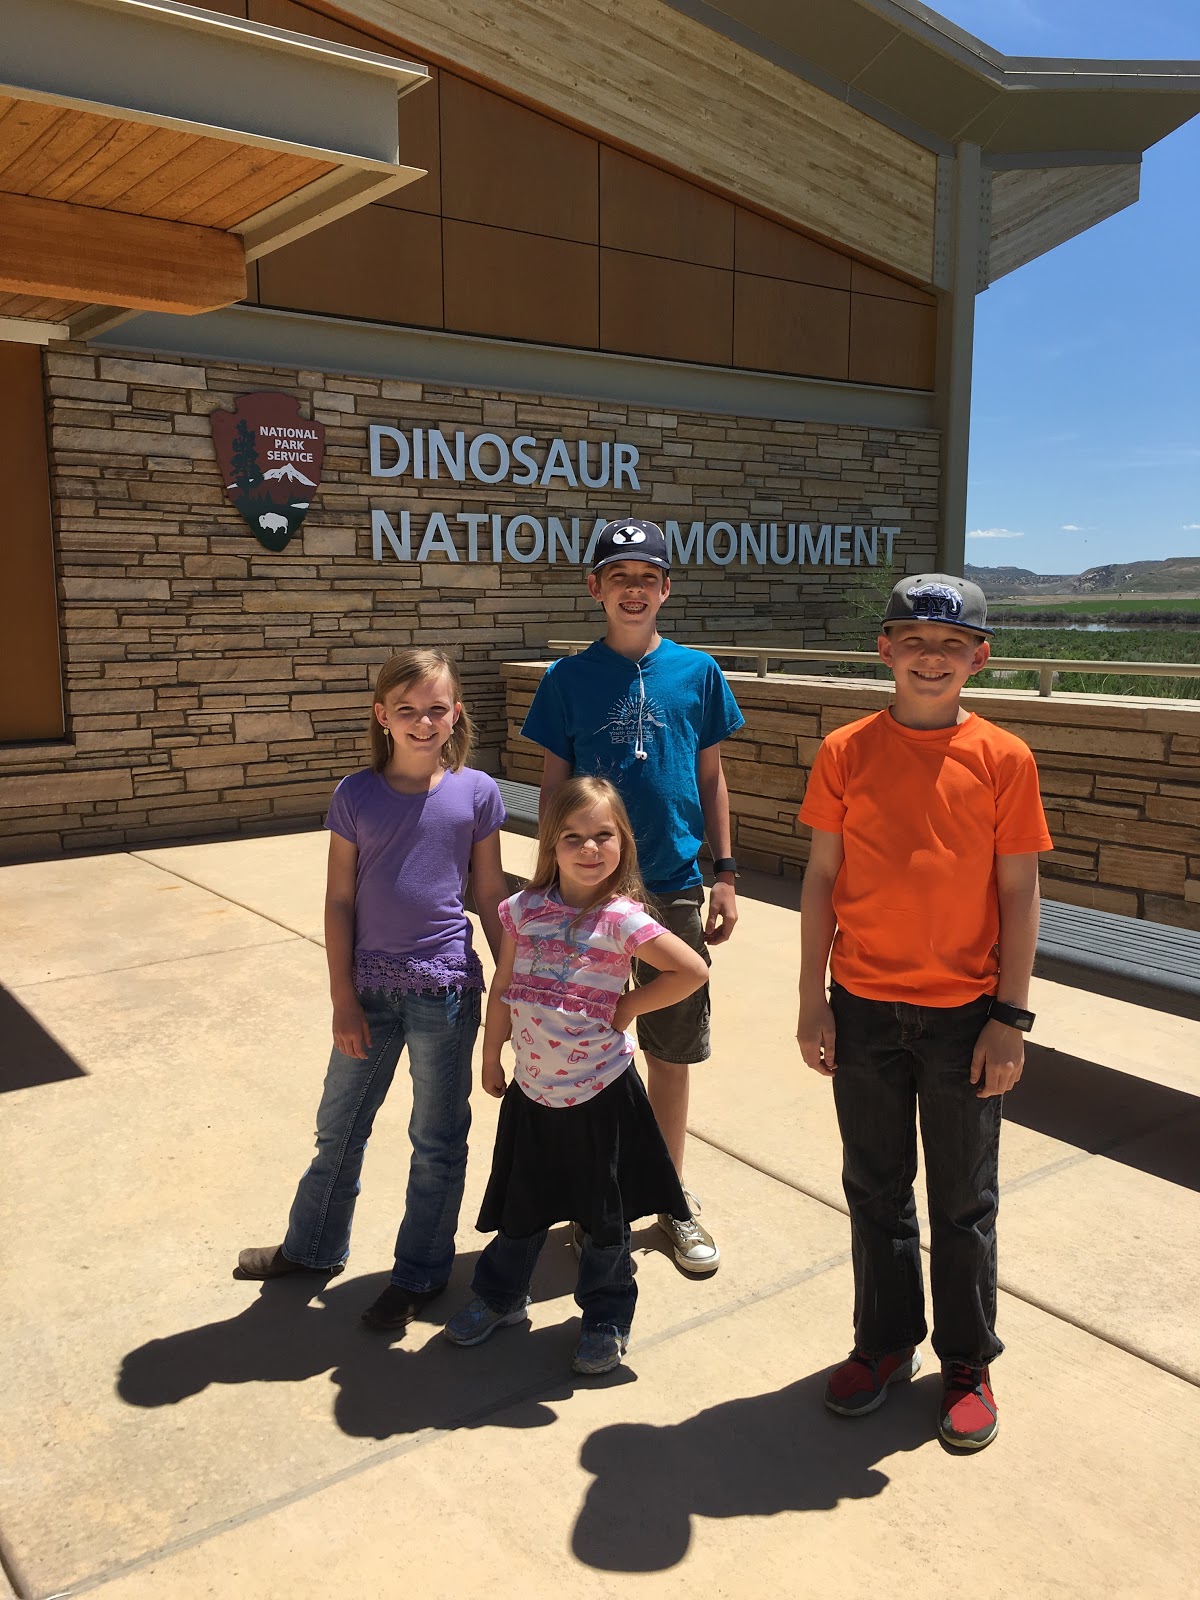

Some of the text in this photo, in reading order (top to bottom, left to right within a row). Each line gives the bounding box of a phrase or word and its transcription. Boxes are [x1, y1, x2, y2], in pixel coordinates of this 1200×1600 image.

[259, 426, 319, 440] NATIONAL
[274, 439, 305, 450] PARK
[266, 450, 314, 463] SERVICE
[369, 424, 641, 491] DINOSAUR
[371, 509, 900, 566] NATION MONUMENT
[615, 528, 642, 544] Y
[912, 594, 963, 620] BYU
